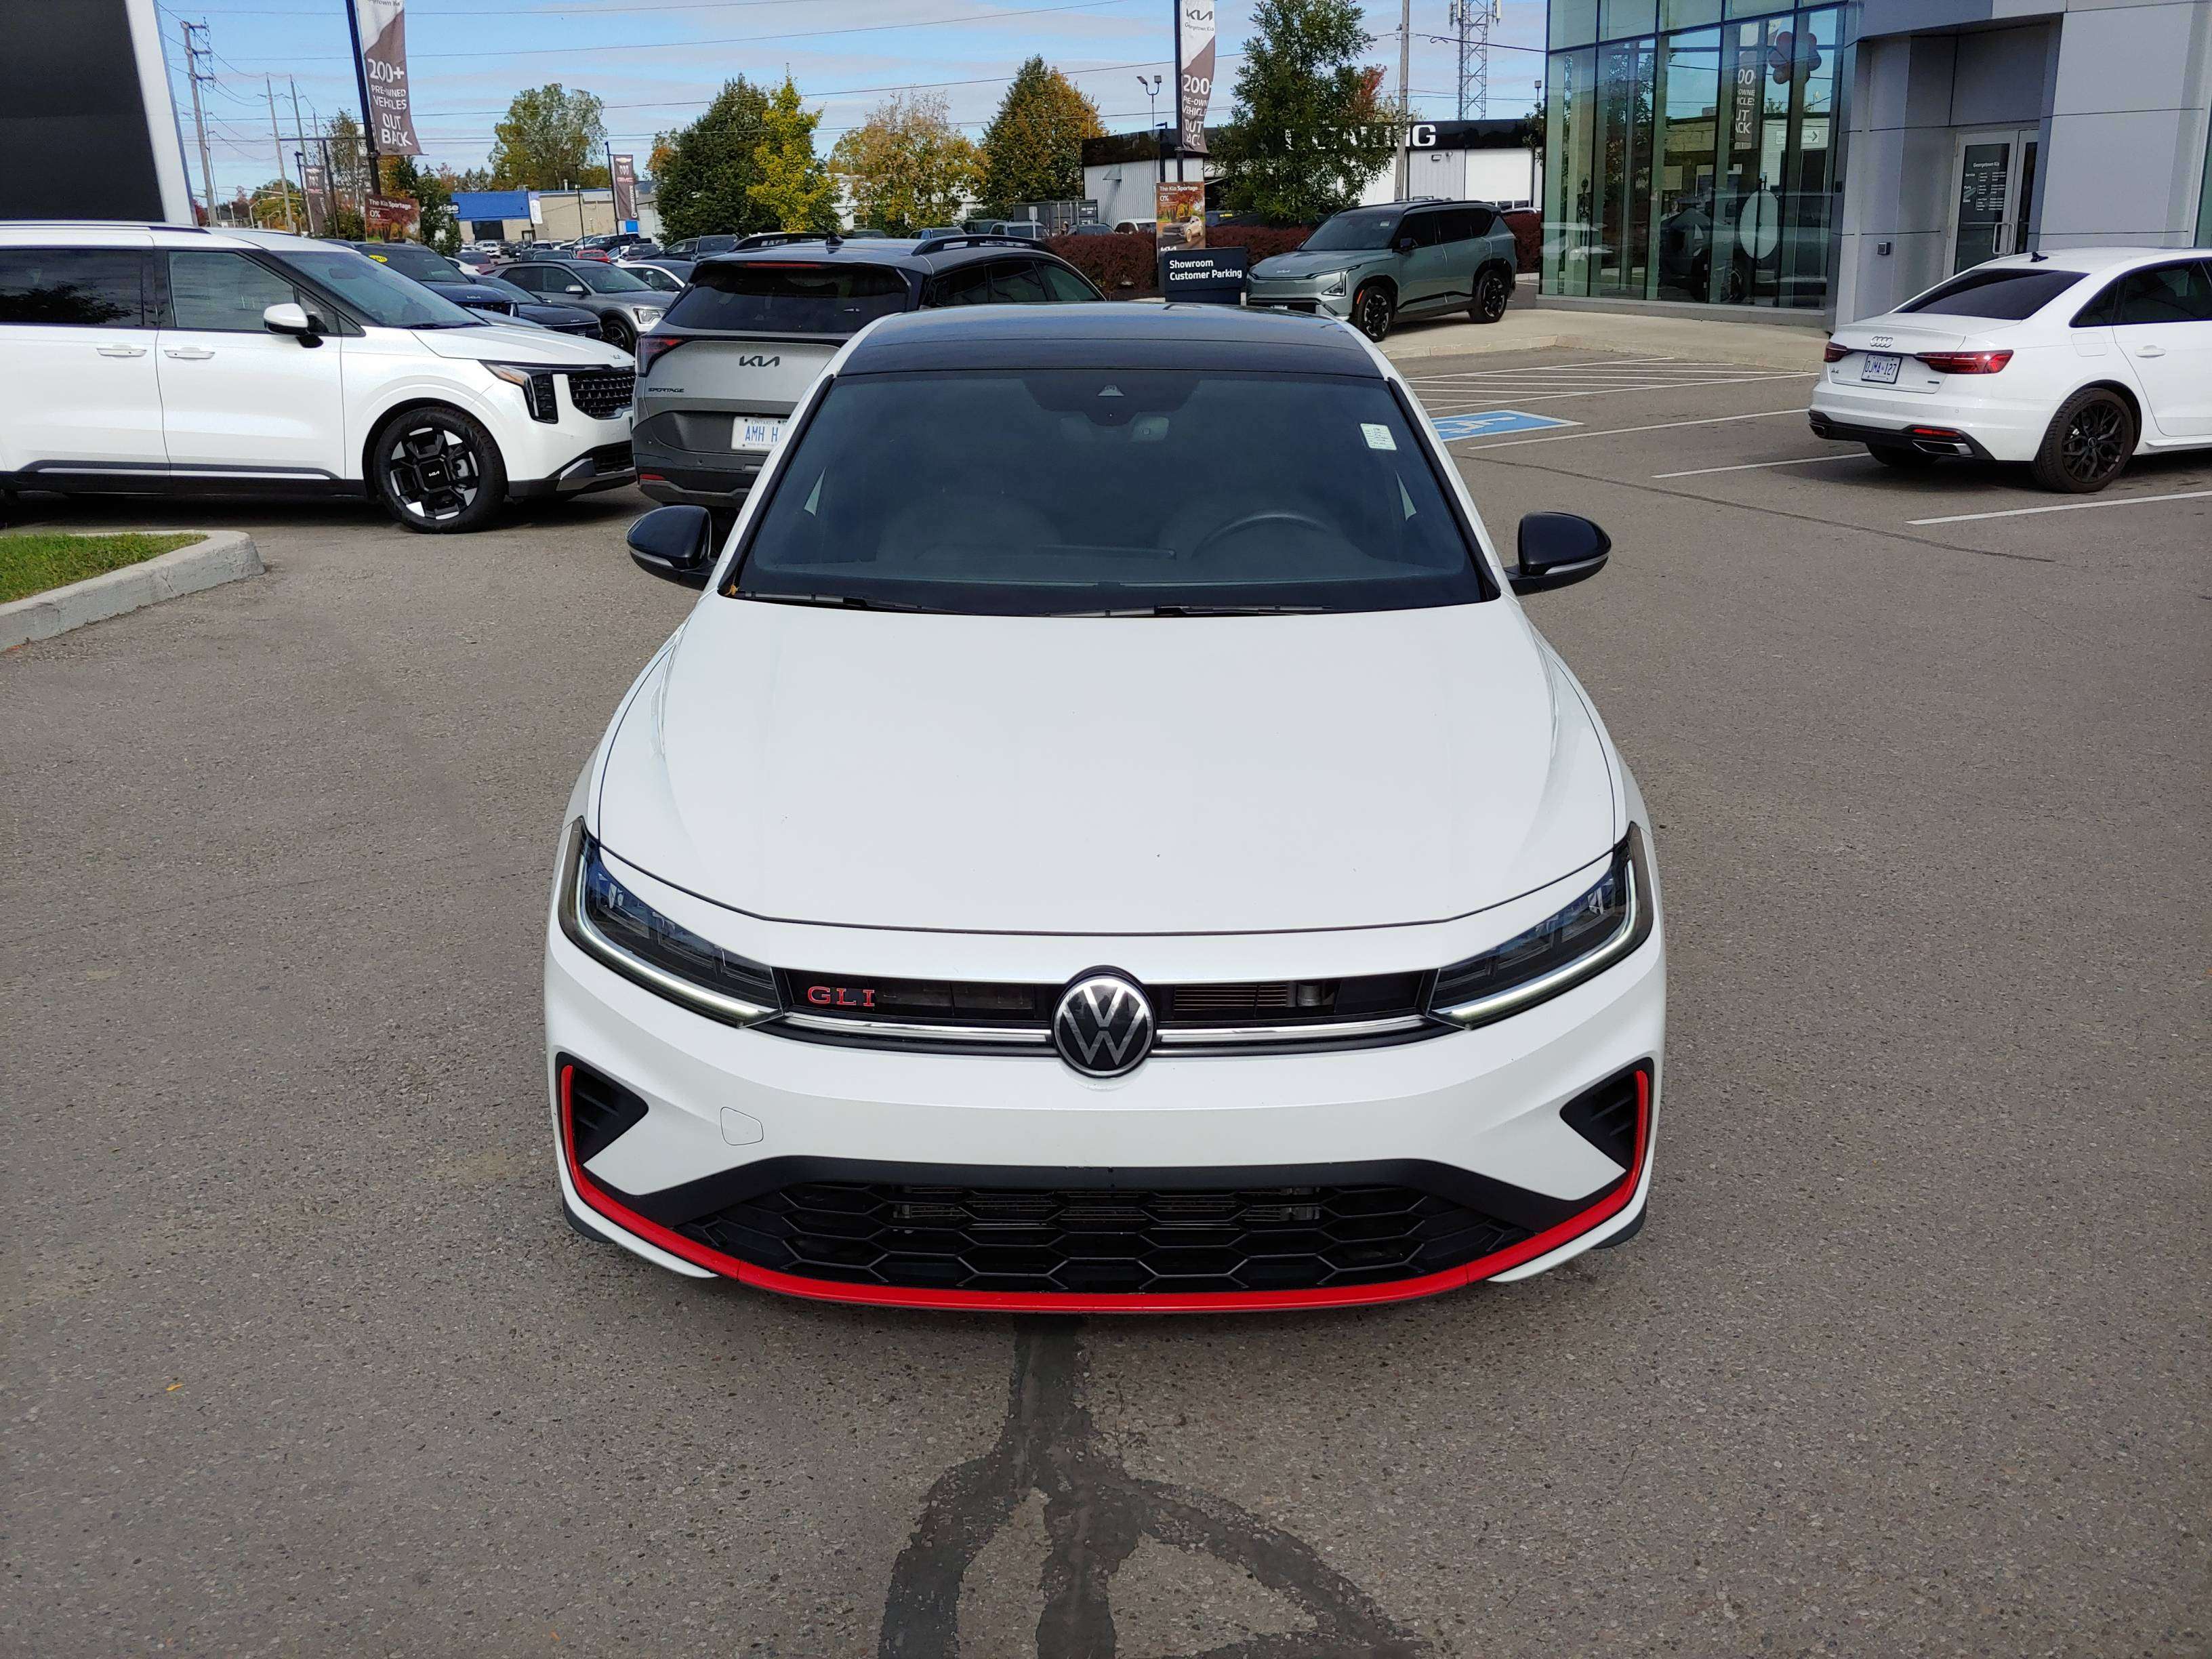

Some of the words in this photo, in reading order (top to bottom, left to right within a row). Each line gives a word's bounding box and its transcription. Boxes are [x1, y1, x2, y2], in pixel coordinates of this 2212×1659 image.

[367, 58, 405, 83] 200+
[381, 128, 413, 147] BACK
[1169, 260, 1214, 269] Showroom
[1170, 271, 1210, 281] Customer
[1211, 268, 1242, 279] Parking
[739, 356, 780, 367] KIA
[745, 425, 765, 443] AMH
[808, 985, 875, 1007] GLI
